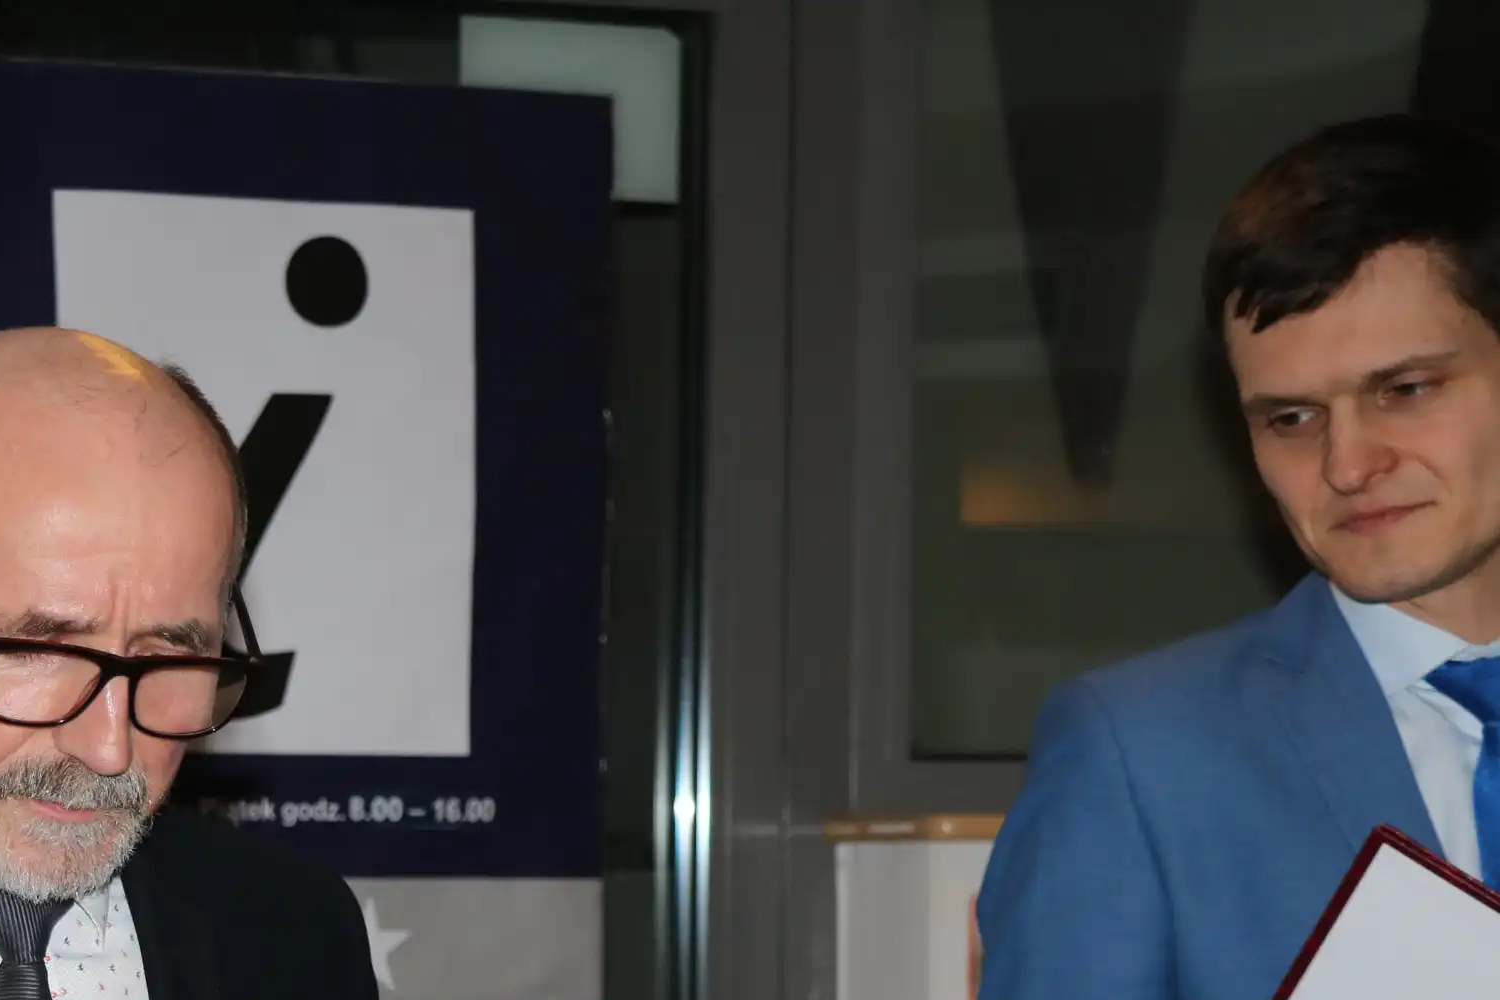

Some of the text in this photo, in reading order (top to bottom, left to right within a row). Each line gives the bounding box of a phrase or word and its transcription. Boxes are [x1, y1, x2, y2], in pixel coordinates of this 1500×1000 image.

[279, 797, 345, 827] godz.
[349, 795, 404, 823] 8.00
[432, 796, 496, 823] 16.00
